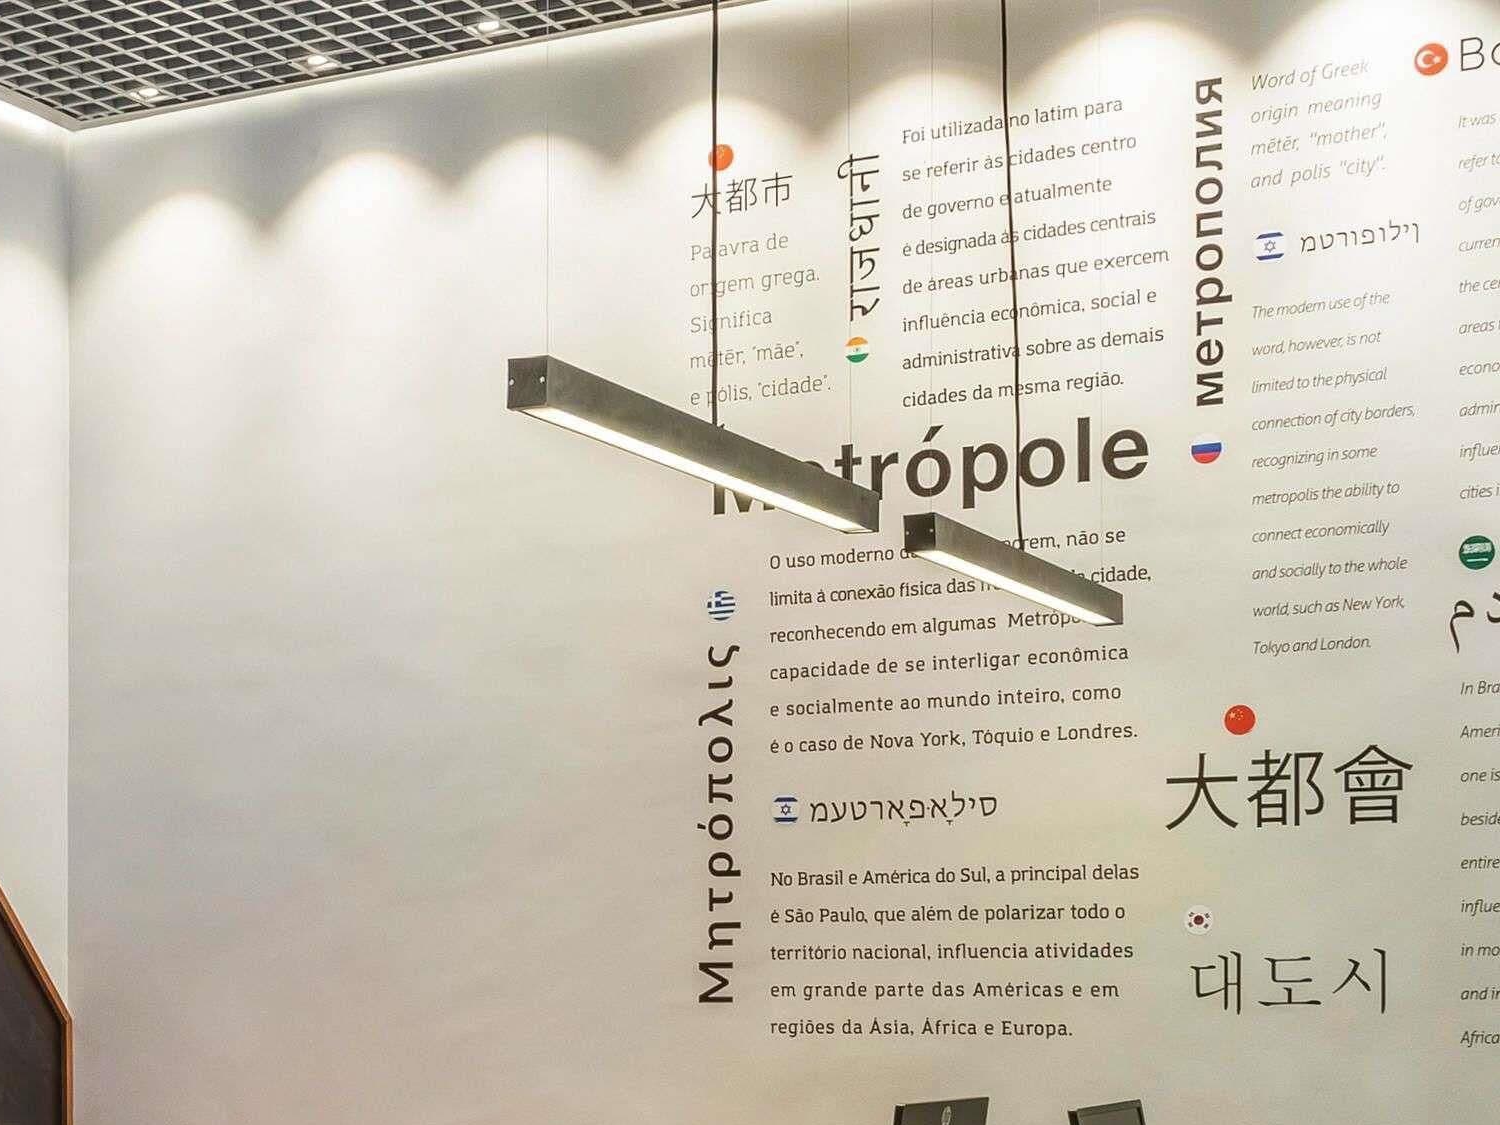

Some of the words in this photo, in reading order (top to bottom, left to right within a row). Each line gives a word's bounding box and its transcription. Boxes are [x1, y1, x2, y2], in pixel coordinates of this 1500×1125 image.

[1252, 69, 1295, 90] Word
[1300, 65, 1318, 83] of
[1251, 103, 1298, 123] origin
[1308, 93, 1382, 114] meaning
[903, 127, 925, 144] Foi
[931, 116, 1004, 139] utilizada
[1009, 113, 1030, 128] no
[1035, 106, 1078, 123] latim
[1084, 100, 1122, 121] para
[903, 169, 921, 182] se
[927, 158, 979, 178] referir
[1009, 145, 1075, 166] cidades
[1081, 137, 1136, 155] centro
[1251, 169, 1283, 188] and
[1290, 164, 1331, 187] polis
[691, 172, 793, 219] 大都市
[691, 240, 760, 261] Paavra
[766, 233, 790, 251] de
[1196, 77, 1233, 407] метрополия
[690, 274, 755, 298] orgem
[1459, 320, 1495, 335] areas
[902, 344, 1022, 371] administrativa
[1026, 338, 1071, 356] sobre
[1077, 337, 1096, 350] as
[1101, 327, 1164, 347] demais
[690, 390, 701, 406] e
[903, 388, 967, 407] cidades
[973, 384, 992, 400] da
[998, 378, 1060, 399] mesma
[1066, 372, 1124, 392] região.
[1252, 413, 1321, 431] connection
[1324, 409, 1339, 427] of
[1340, 408, 1362, 425] city
[1365, 404, 1415, 420] borders,
[713, 417, 1149, 516] trópole
[1252, 449, 1324, 469] recognizing
[1327, 448, 1339, 461] in
[1341, 447, 1378, 460] some
[1459, 485, 1493, 500] cities
[1066, 530, 1099, 547] não
[1105, 530, 1126, 543] se
[770, 555, 780, 569] O
[786, 555, 815, 568] uso
[821, 548, 894, 565] moderno
[1252, 565, 1277, 580] and
[1279, 562, 1326, 578] socially
[1329, 563, 1342, 574] to
[1344, 560, 1365, 573] the
[1368, 557, 1408, 571] whole
[1253, 641, 1290, 656] Tokyo
[1292, 638, 1318, 652] and
[1320, 636, 1371, 650] London.
[770, 660, 870, 682] capacidade
[877, 658, 898, 673] de
[905, 660, 925, 672] se
[933, 652, 1020, 671] interligar
[1028, 645, 1128, 665] econômica
[1460, 681, 1473, 696] In
[770, 706, 779, 717] e
[786, 697, 893, 716] socialmente
[900, 698, 920, 710] ao
[927, 691, 990, 709] mundo
[998, 688, 1064, 705] inteiro,
[1072, 687, 1121, 701] como
[785, 742, 793, 753] o
[799, 739, 837, 752] caso
[843, 735, 863, 750] de
[870, 734, 914, 749] Nova
[920, 730, 965, 747] York,
[972, 727, 1034, 746] Tóquio
[1040, 730, 1050, 741] e
[1057, 723, 1137, 740] Londres.
[1165, 744, 1414, 831] 大都會
[1460, 770, 1487, 783] one
[697, 643, 742, 1004] Μητρόπολις
[771, 872, 792, 886] No
[798, 870, 843, 886] Brasil
[849, 873, 857, 885] e
[862, 869, 930, 884] América
[935, 867, 955, 883] do
[961, 866, 990, 883] Sul,
[996, 870, 1005, 882] a
[1010, 864, 1086, 885] principal
[1093, 864, 1139, 880] delas
[785, 908, 814, 923] São
[819, 907, 868, 923] Paulo,
[874, 910, 905, 925] que
[911, 906, 952, 921] além
[958, 905, 979, 921] de
[985, 904, 1065, 924] polarizar
[1071, 903, 1109, 919] todo
[1115, 907, 1125, 919] o
[770, 945, 846, 960] território
[853, 944, 931, 960] nacional,
[938, 943, 1028, 959] influencia
[1035, 942, 1133, 958] atividades
[771, 986, 796, 997] em
[803, 982, 867, 1001] grande
[875, 982, 924, 1000] parte
[932, 981, 964, 997] das
[973, 982, 1063, 997] Américas
[1072, 985, 1082, 997] e
[1091, 985, 1119, 997] em
[1190, 948, 1386, 1016] 대도시
[1460, 986, 1488, 1001] and
[771, 1019, 834, 1038] regiões
[842, 1019, 862, 1034] da
[869, 1017, 914, 1036] Ásia,
[921, 1017, 977, 1035] África
[984, 1024, 994, 1035] e
[1002, 1021, 1072, 1039] Europa.
